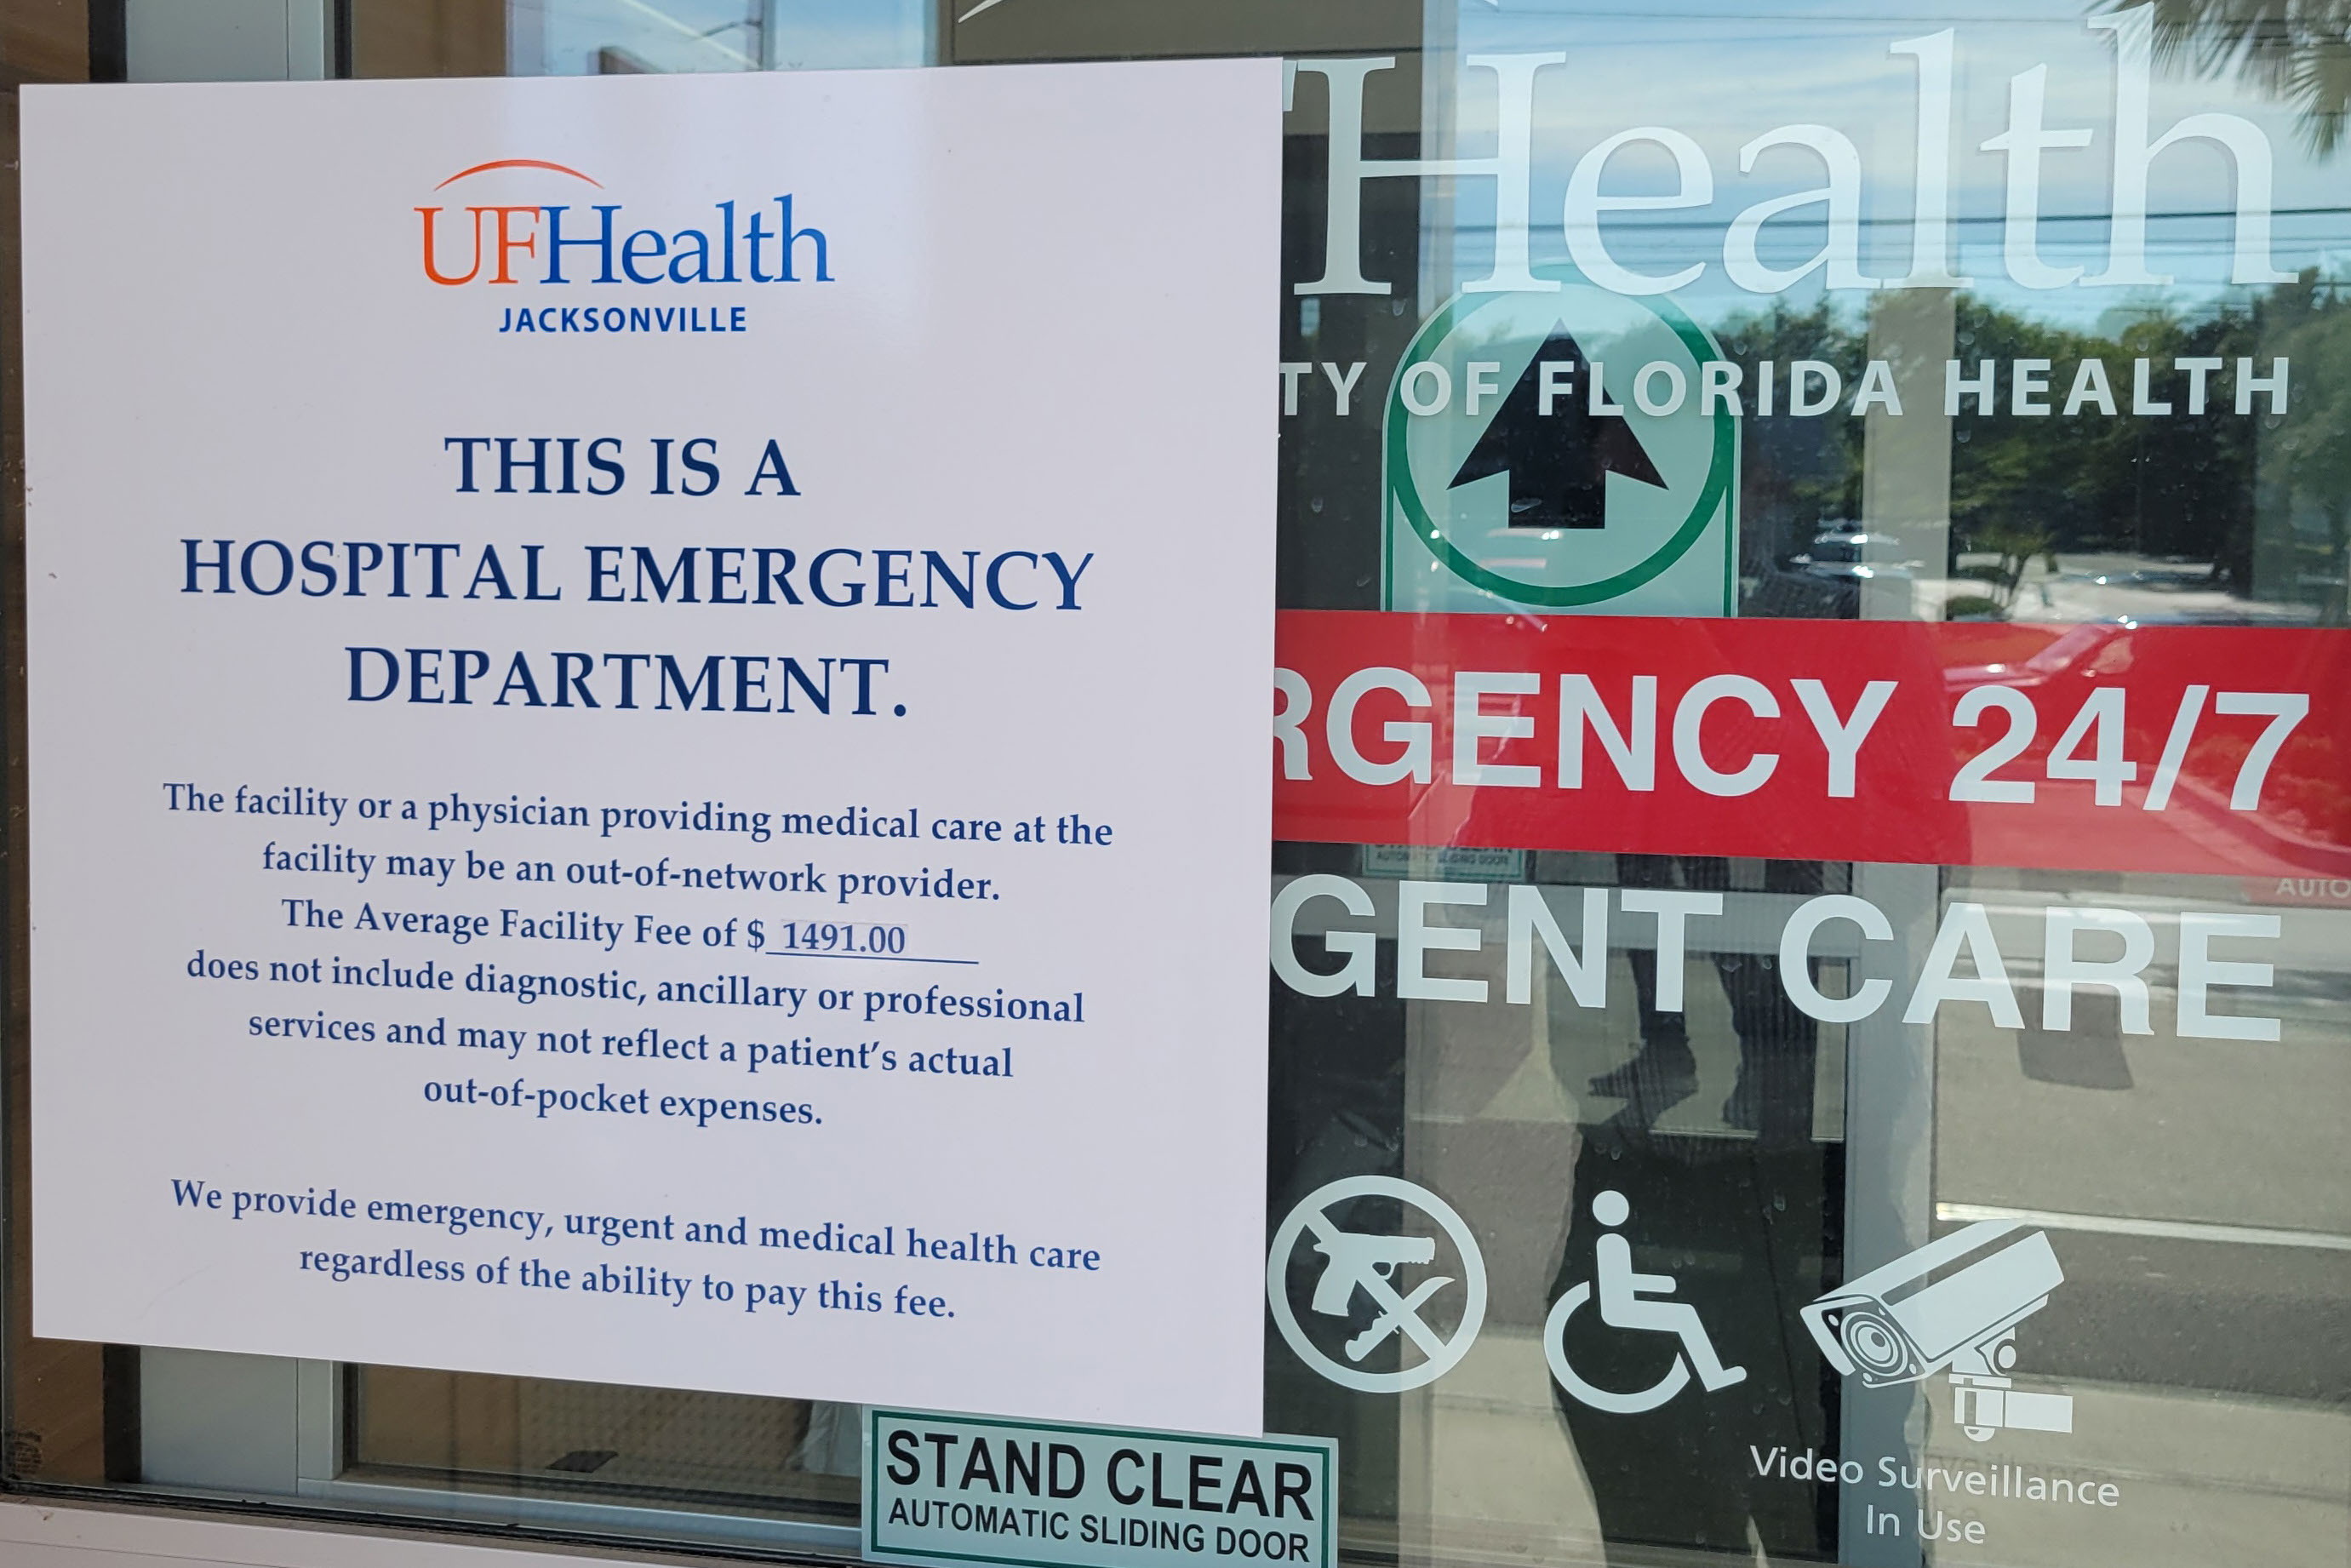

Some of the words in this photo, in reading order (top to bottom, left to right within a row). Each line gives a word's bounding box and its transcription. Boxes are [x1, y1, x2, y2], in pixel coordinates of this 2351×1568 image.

[1283, 3, 2298, 295] Health
[497, 306, 746, 334] JACKSONVILLE
[1399, 361, 1501, 416] OF
[1537, 359, 1903, 417] FLORIDA
[1943, 357, 2290, 416] HEALTH
[444, 438, 625, 496] THIS
[650, 438, 720, 496] IS
[745, 438, 802, 496] A
[180, 539, 562, 601] HOSPITAL
[585, 546, 1095, 611] EMERGENCY
[345, 647, 907, 717] DEPARTMENT.
[1948, 684, 2309, 811] 24/7
[163, 783, 225, 813] The
[235, 785, 348, 827] facility
[358, 798, 392, 819] or
[402, 801, 418, 820] a
[428, 793, 590, 833] physician
[600, 801, 771, 843] providing
[781, 806, 920, 838] medical
[931, 820, 1002, 842] care
[1013, 815, 1046, 844] at
[1056, 814, 1113, 845] the
[262, 841, 376, 883] facility
[386, 854, 456, 887] may
[466, 850, 505, 880] be
[516, 861, 556, 882] an
[566, 857, 827, 893] out-of-network
[837, 867, 999, 903] provider.
[282, 898, 344, 929] The
[354, 902, 489, 944] Average
[500, 908, 624, 952] Facility
[634, 914, 691, 946] Fee
[702, 918, 738, 947] of
[782, 922, 906, 954] 1491.00
[186, 950, 260, 980] does
[269, 956, 323, 984] not
[331, 956, 454, 990] include
[465, 964, 647, 1005] diagnostic,
[657, 975, 808, 1017] ancillary
[818, 989, 854, 1010] or
[863, 985, 1085, 1022] professional
[1779, 894, 2281, 1042] CARE
[249, 1010, 376, 1042] services
[386, 1017, 447, 1046] and
[458, 1027, 526, 1060] may
[536, 1028, 592, 1056] not
[602, 1028, 709, 1061] reflect
[719, 1041, 737, 1062] a
[747, 1037, 897, 1073] patient’s
[908, 1047, 1014, 1078] actual
[424, 1079, 649, 1119] out-of-pocket
[659, 1096, 822, 1128] expenses.
[170, 1179, 222, 1209] We
[232, 1187, 357, 1221] provide
[367, 1201, 553, 1241] emergency,
[563, 1214, 675, 1246] urgent
[684, 1216, 748, 1246] and
[758, 1222, 895, 1256] medical
[906, 1228, 1018, 1265] health
[1029, 1246, 1101, 1272] care
[300, 1249, 465, 1282] regardless
[476, 1256, 510, 1285] of
[519, 1259, 571, 1290] the
[581, 1264, 693, 1307] ability
[702, 1274, 735, 1302] to
[745, 1283, 808, 1316] pay
[817, 1280, 883, 1313] this
[894, 1285, 955, 1318] fee.
[886, 1429, 1085, 1499] STAND
[1107, 1448, 1315, 1521] CLEAR
[1749, 1445, 1864, 1484] Video
[1878, 1456, 2119, 1507] Surveillance
[888, 1497, 1070, 1541] AUTOMATIC
[1080, 1514, 1204, 1553] SLIDING
[1216, 1527, 1310, 1563] DOOR
[1866, 1505, 1900, 1537] In
[1917, 1509, 1986, 1544] Use
